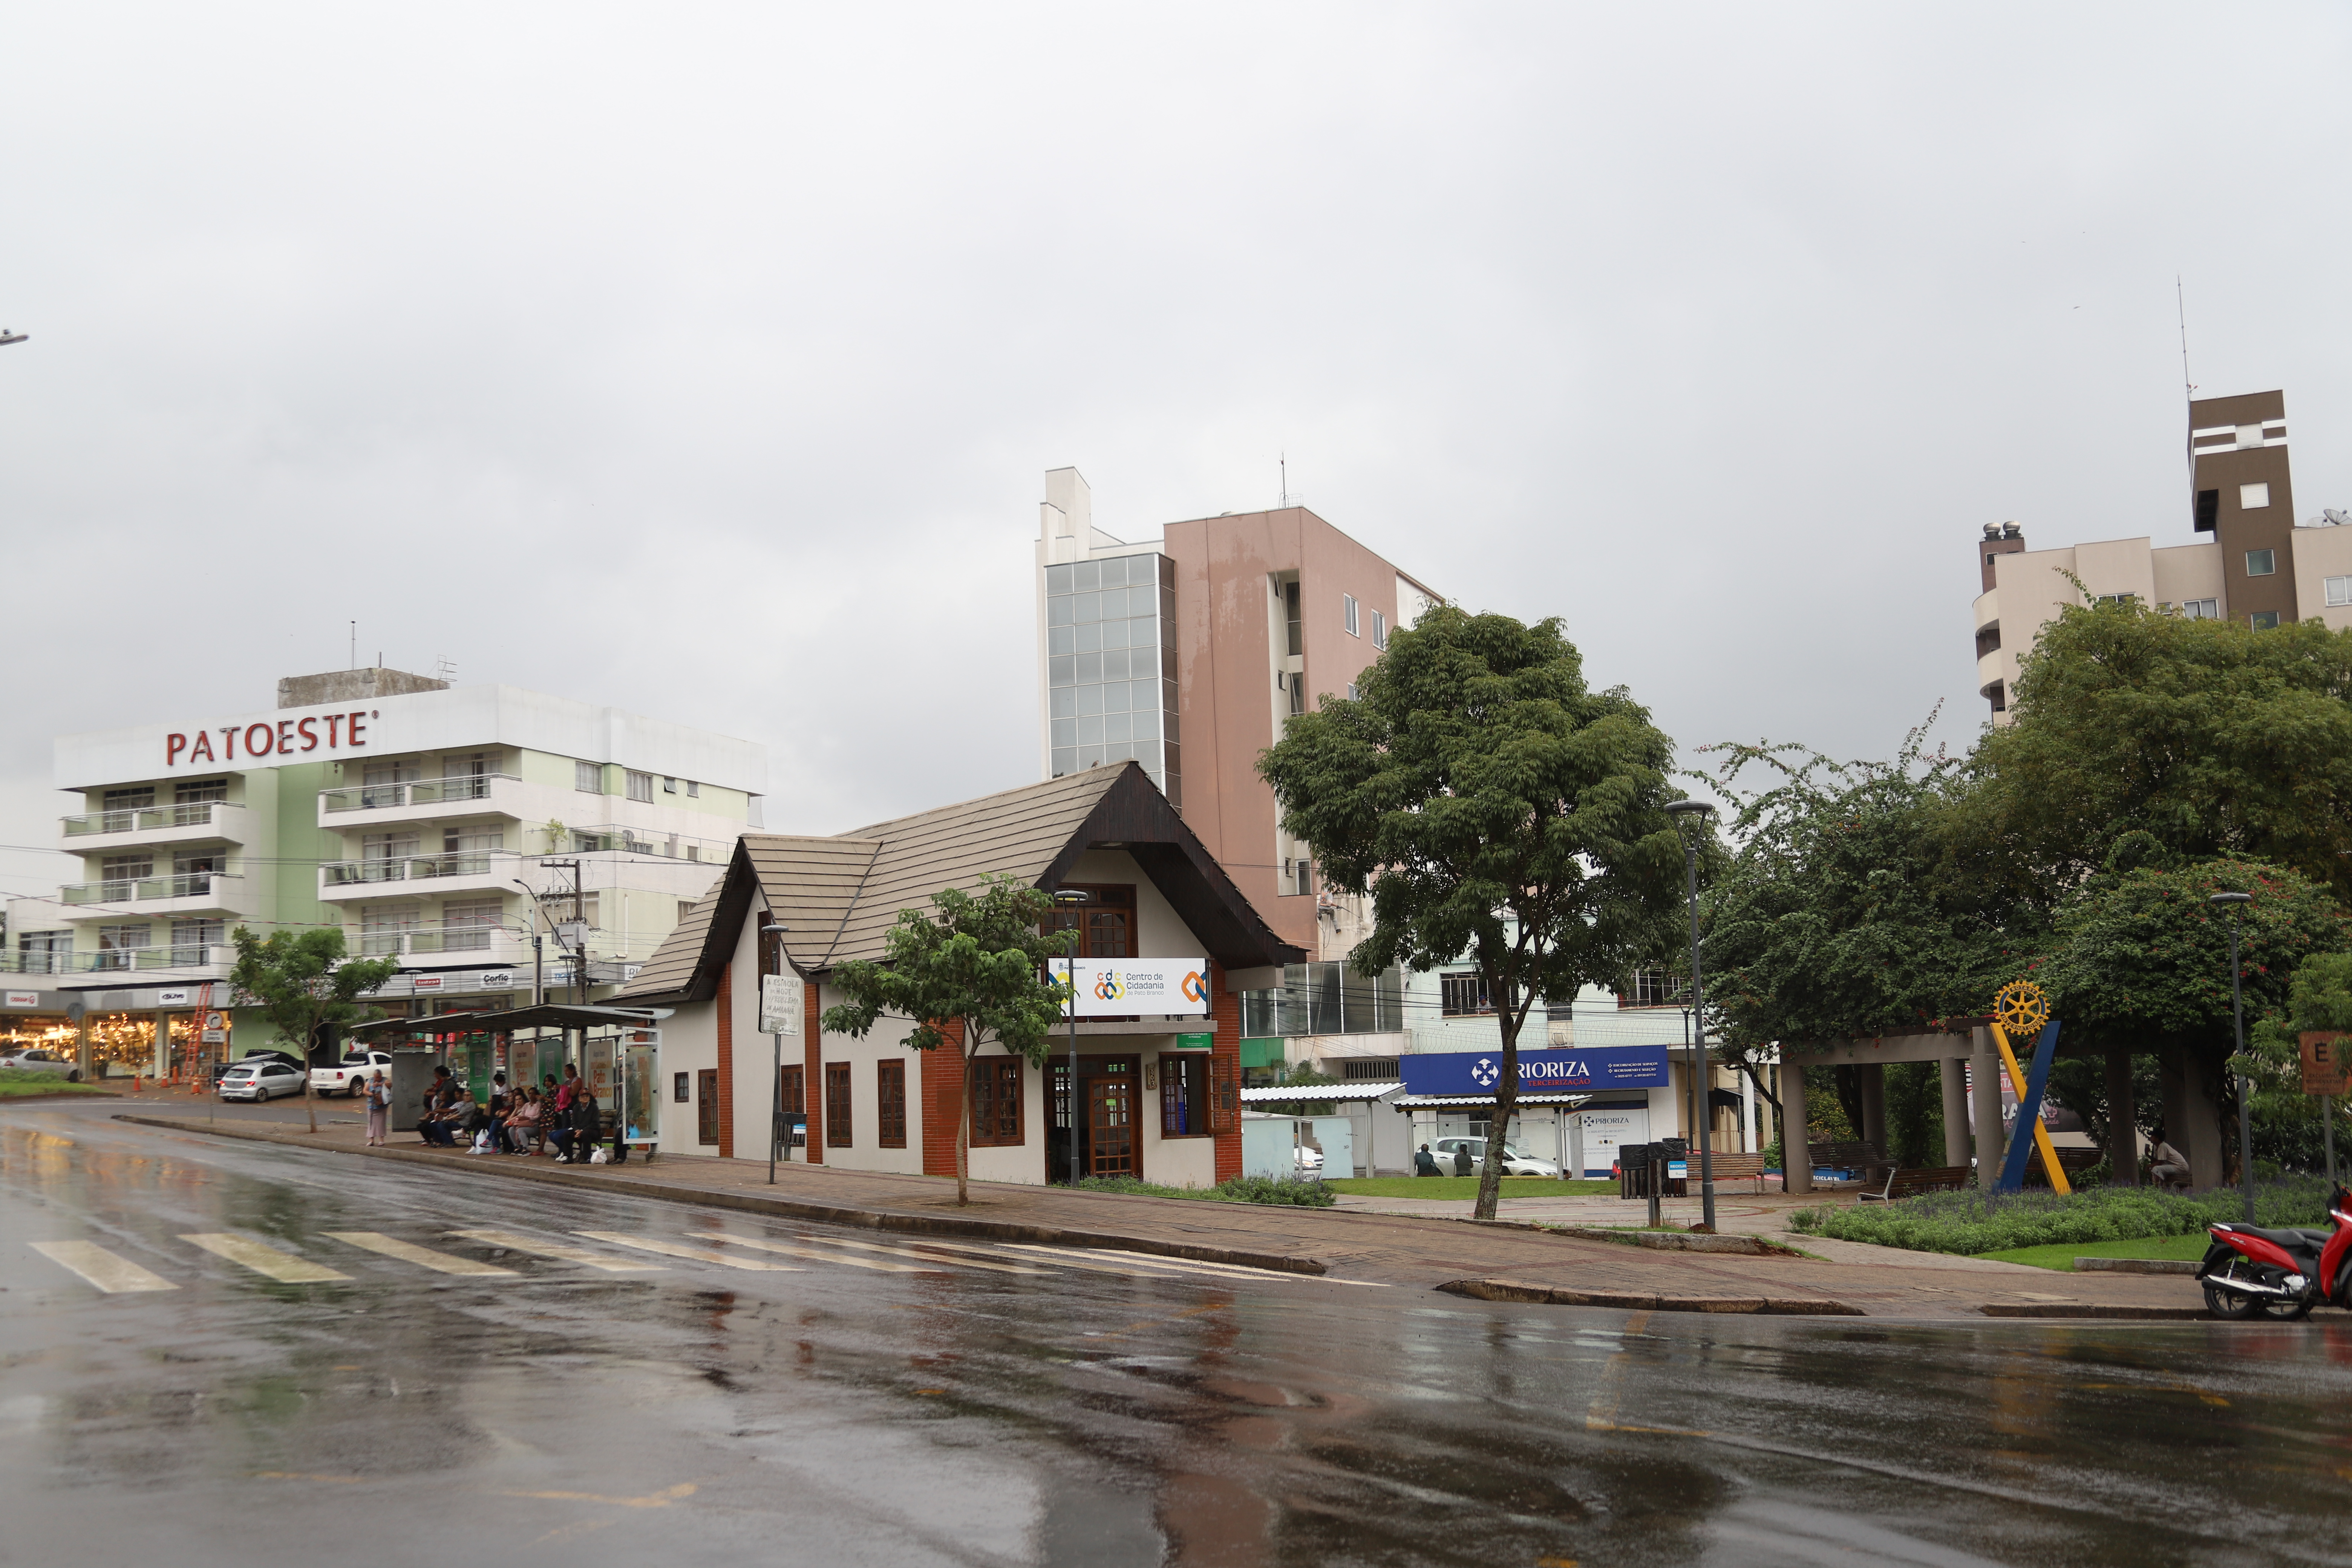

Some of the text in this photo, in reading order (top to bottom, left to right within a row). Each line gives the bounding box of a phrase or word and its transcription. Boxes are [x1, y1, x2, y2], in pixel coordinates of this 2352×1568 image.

[773, 979, 799, 988] ESMOLA
[771, 995, 799, 1005] PROBLEMA
[2001, 1015, 2043, 1030] INTERNATIONAL
[2315, 1043, 2328, 1062] E
[1517, 1061, 1590, 1078] RIORIZA
[594, 1070, 606, 1084] Pato
[1528, 1077, 1591, 1087] TERCEIRIZAÇÃO
[594, 1084, 612, 1098] Branco
